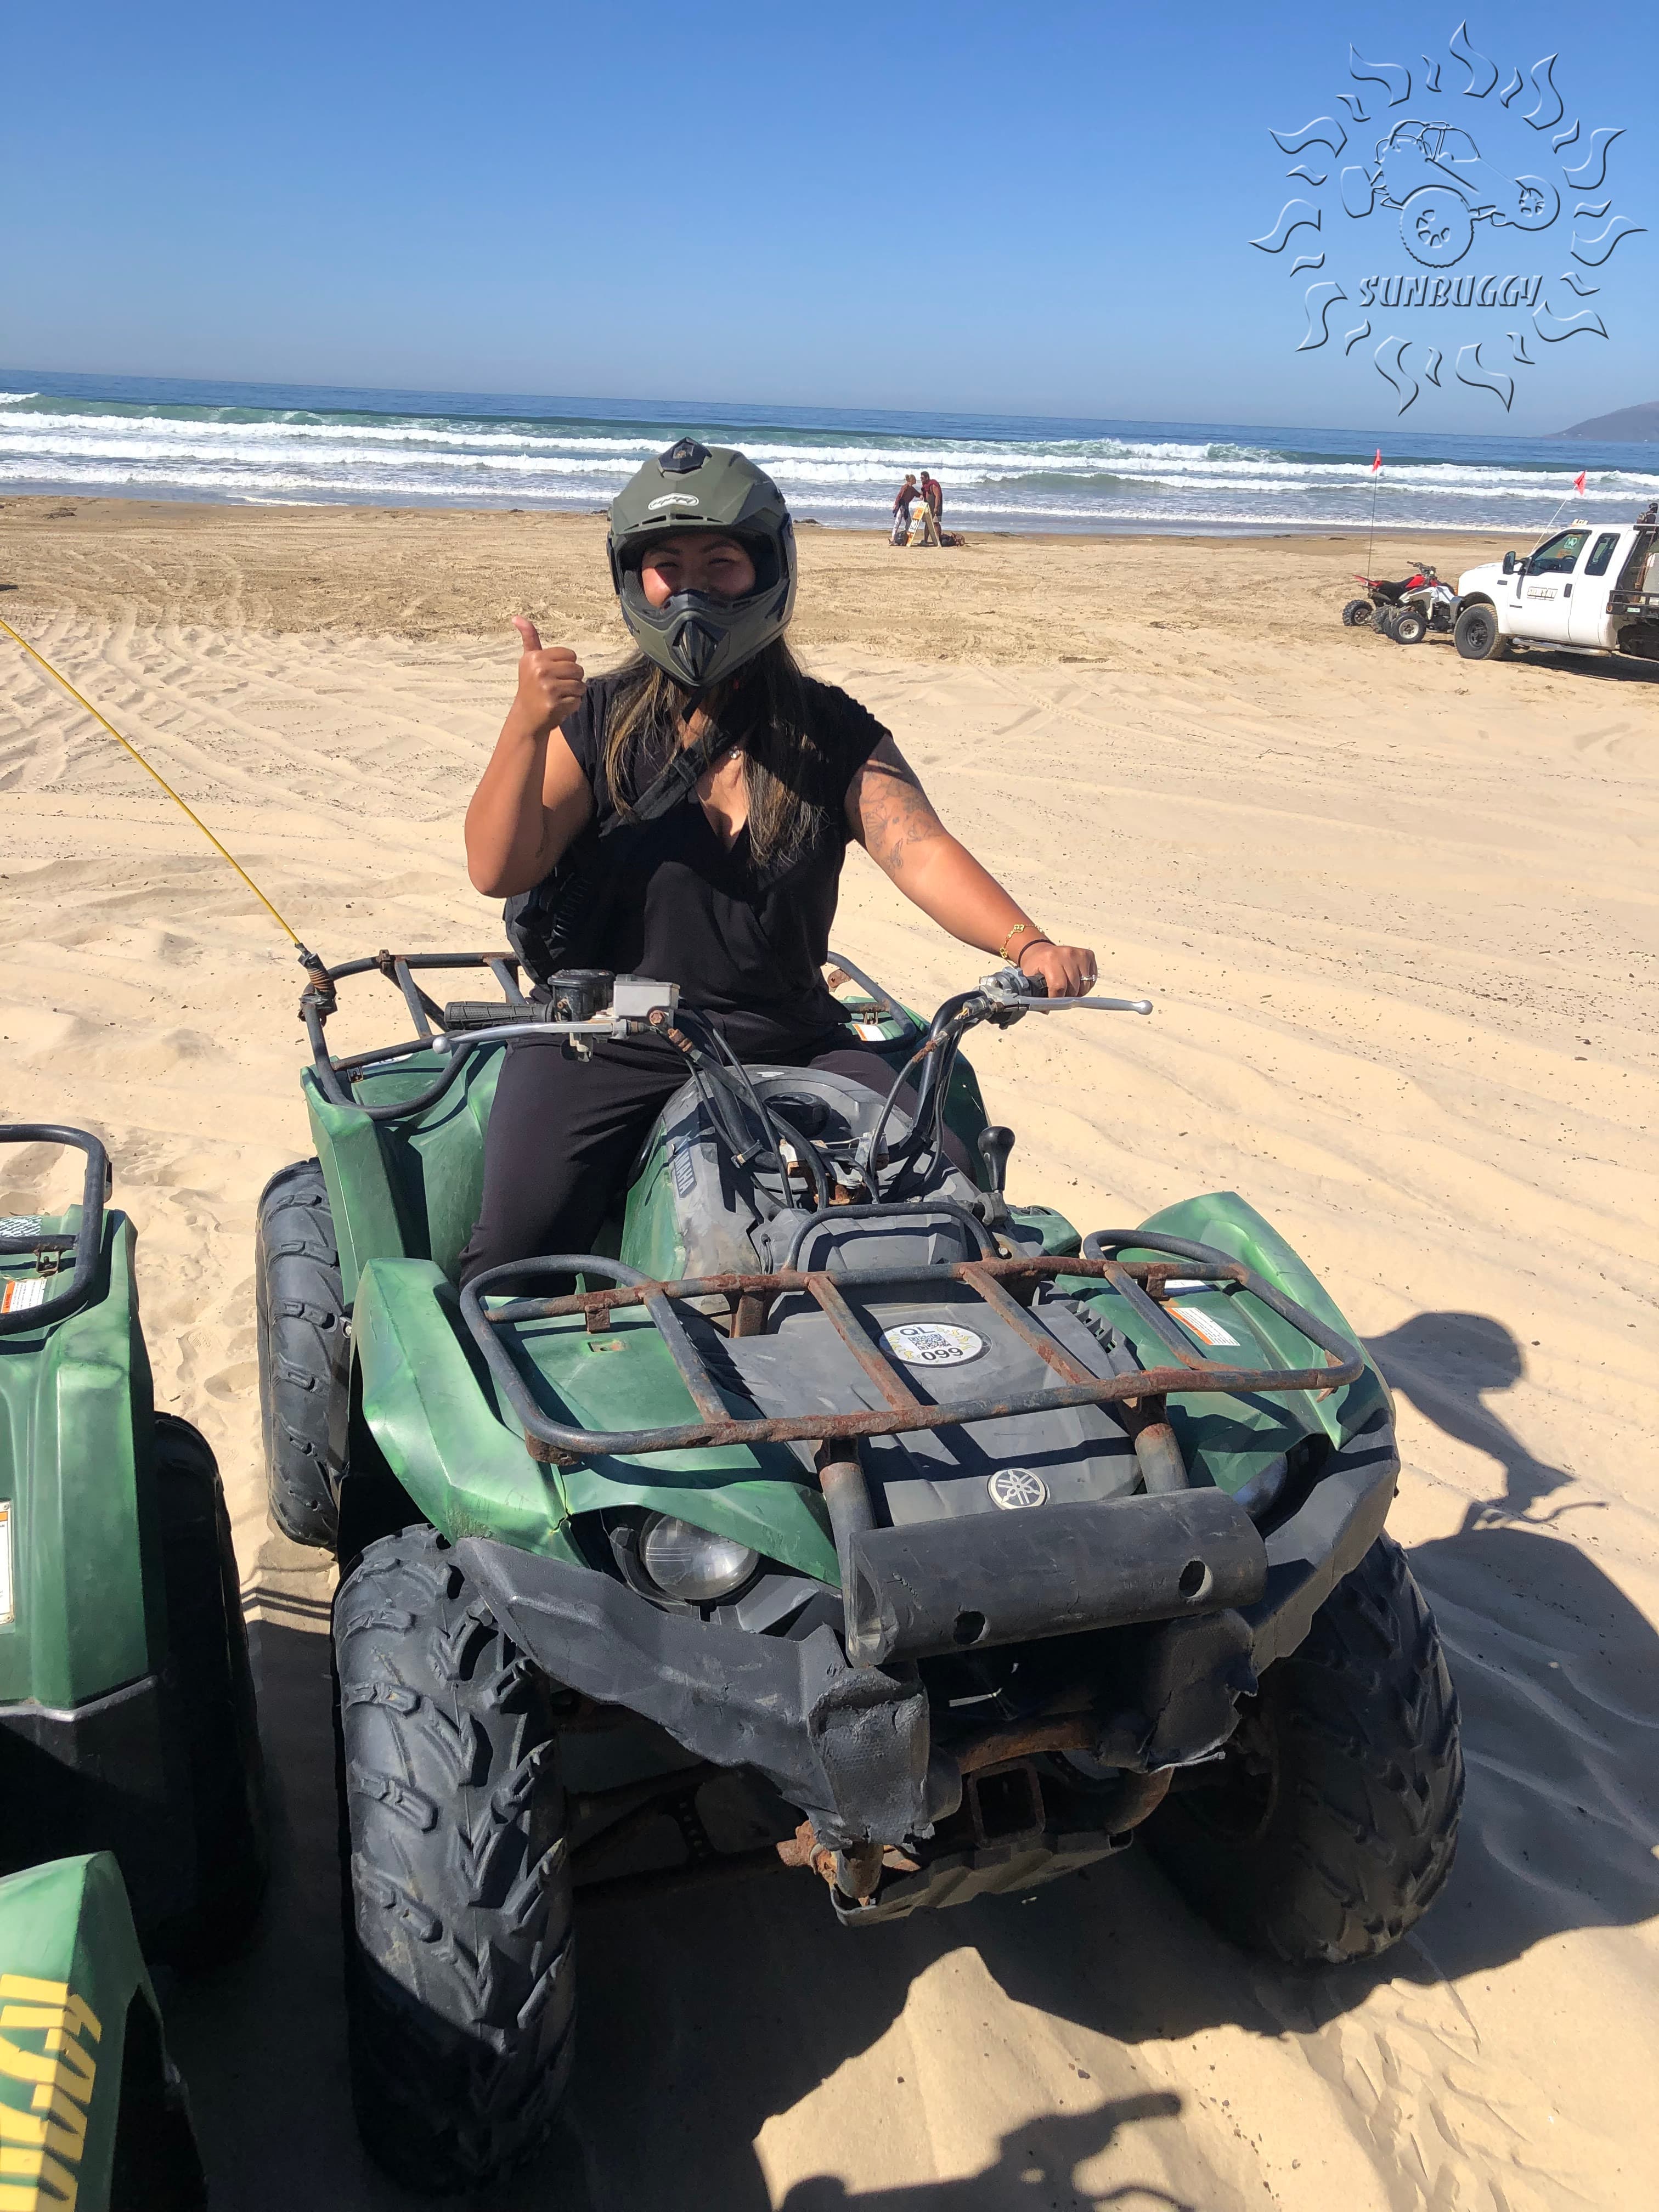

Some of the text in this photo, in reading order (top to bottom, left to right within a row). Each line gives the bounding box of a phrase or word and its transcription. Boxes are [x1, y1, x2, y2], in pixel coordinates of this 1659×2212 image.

[674, 1138, 695, 1195] YAMAHA
[899, 1326, 935, 1335] QL
[921, 1347, 964, 1361] 099
